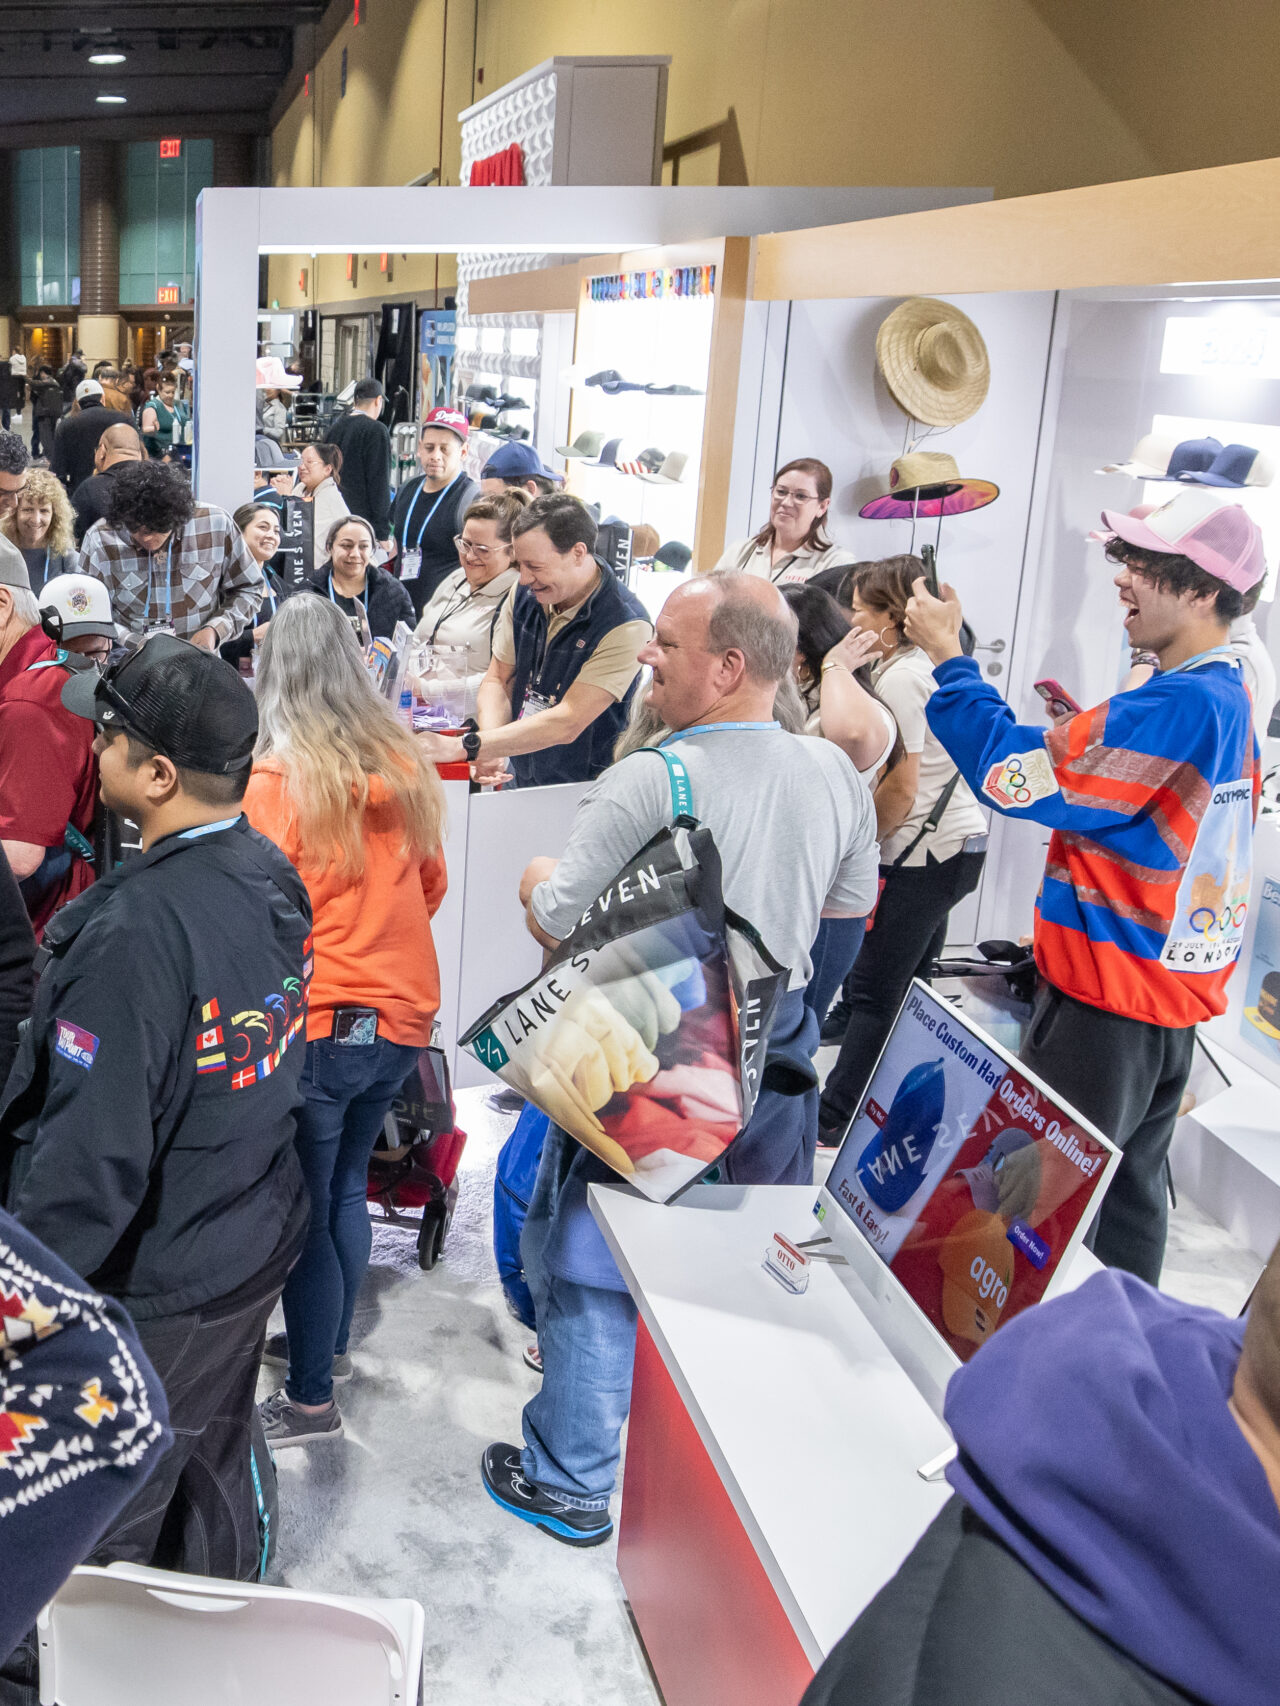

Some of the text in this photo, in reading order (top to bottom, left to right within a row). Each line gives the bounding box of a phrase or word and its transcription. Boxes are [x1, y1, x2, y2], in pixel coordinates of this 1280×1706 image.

[159, 140, 180, 158] EXIT
[159, 288, 178, 304] EXIT
[676, 779, 688, 807] LANE
[1213, 787, 1250, 805] OLYMPIC
[504, 979, 572, 1046] LANE
[906, 995, 937, 1032] Place
[936, 1021, 979, 1071] Custom
[976, 1058, 1002, 1091] Hat
[999, 1079, 1047, 1131] Orders
[1044, 1120, 1102, 1178] Online!
[838, 1178, 889, 1245] Fast & Easy!
[1013, 1225, 1045, 1260] Order Now!
[777, 1249, 796, 1271] OTTO
[970, 1256, 1007, 1308] agro
